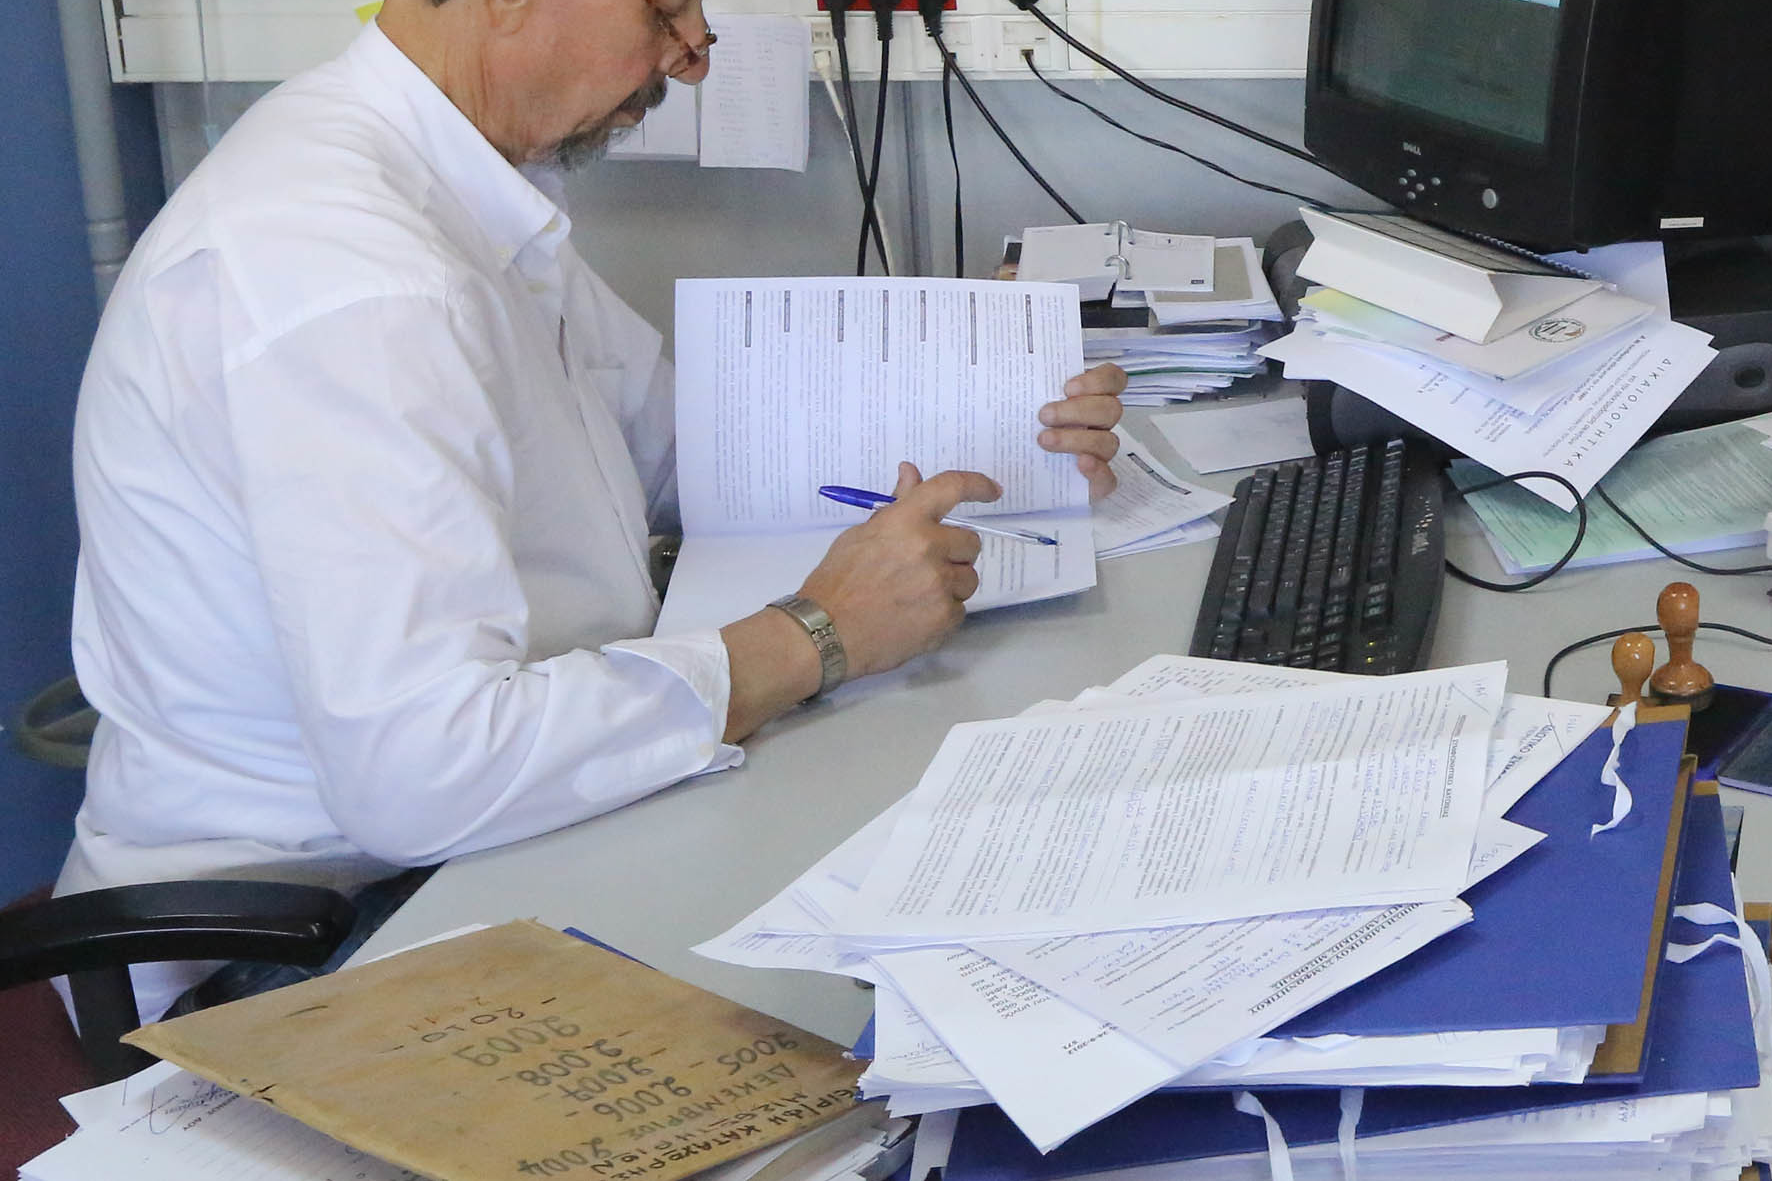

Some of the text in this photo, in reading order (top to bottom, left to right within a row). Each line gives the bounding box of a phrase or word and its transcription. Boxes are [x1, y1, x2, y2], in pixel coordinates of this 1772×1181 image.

[1563, 358, 1672, 467] ΔΙΚΑΙΟΛΟΓΗΤΙΚΑ
[421, 1006, 526, 1043] 2010
[455, 1015, 582, 1067] 2009
[518, 1038, 624, 1087] 2008
[558, 1055, 653, 1102] 2007
[593, 1032, 799, 1121] 2005 2006
[517, 1063, 797, 1179] ΔΕΚΕΜΒΡΙΟΣ 2004
